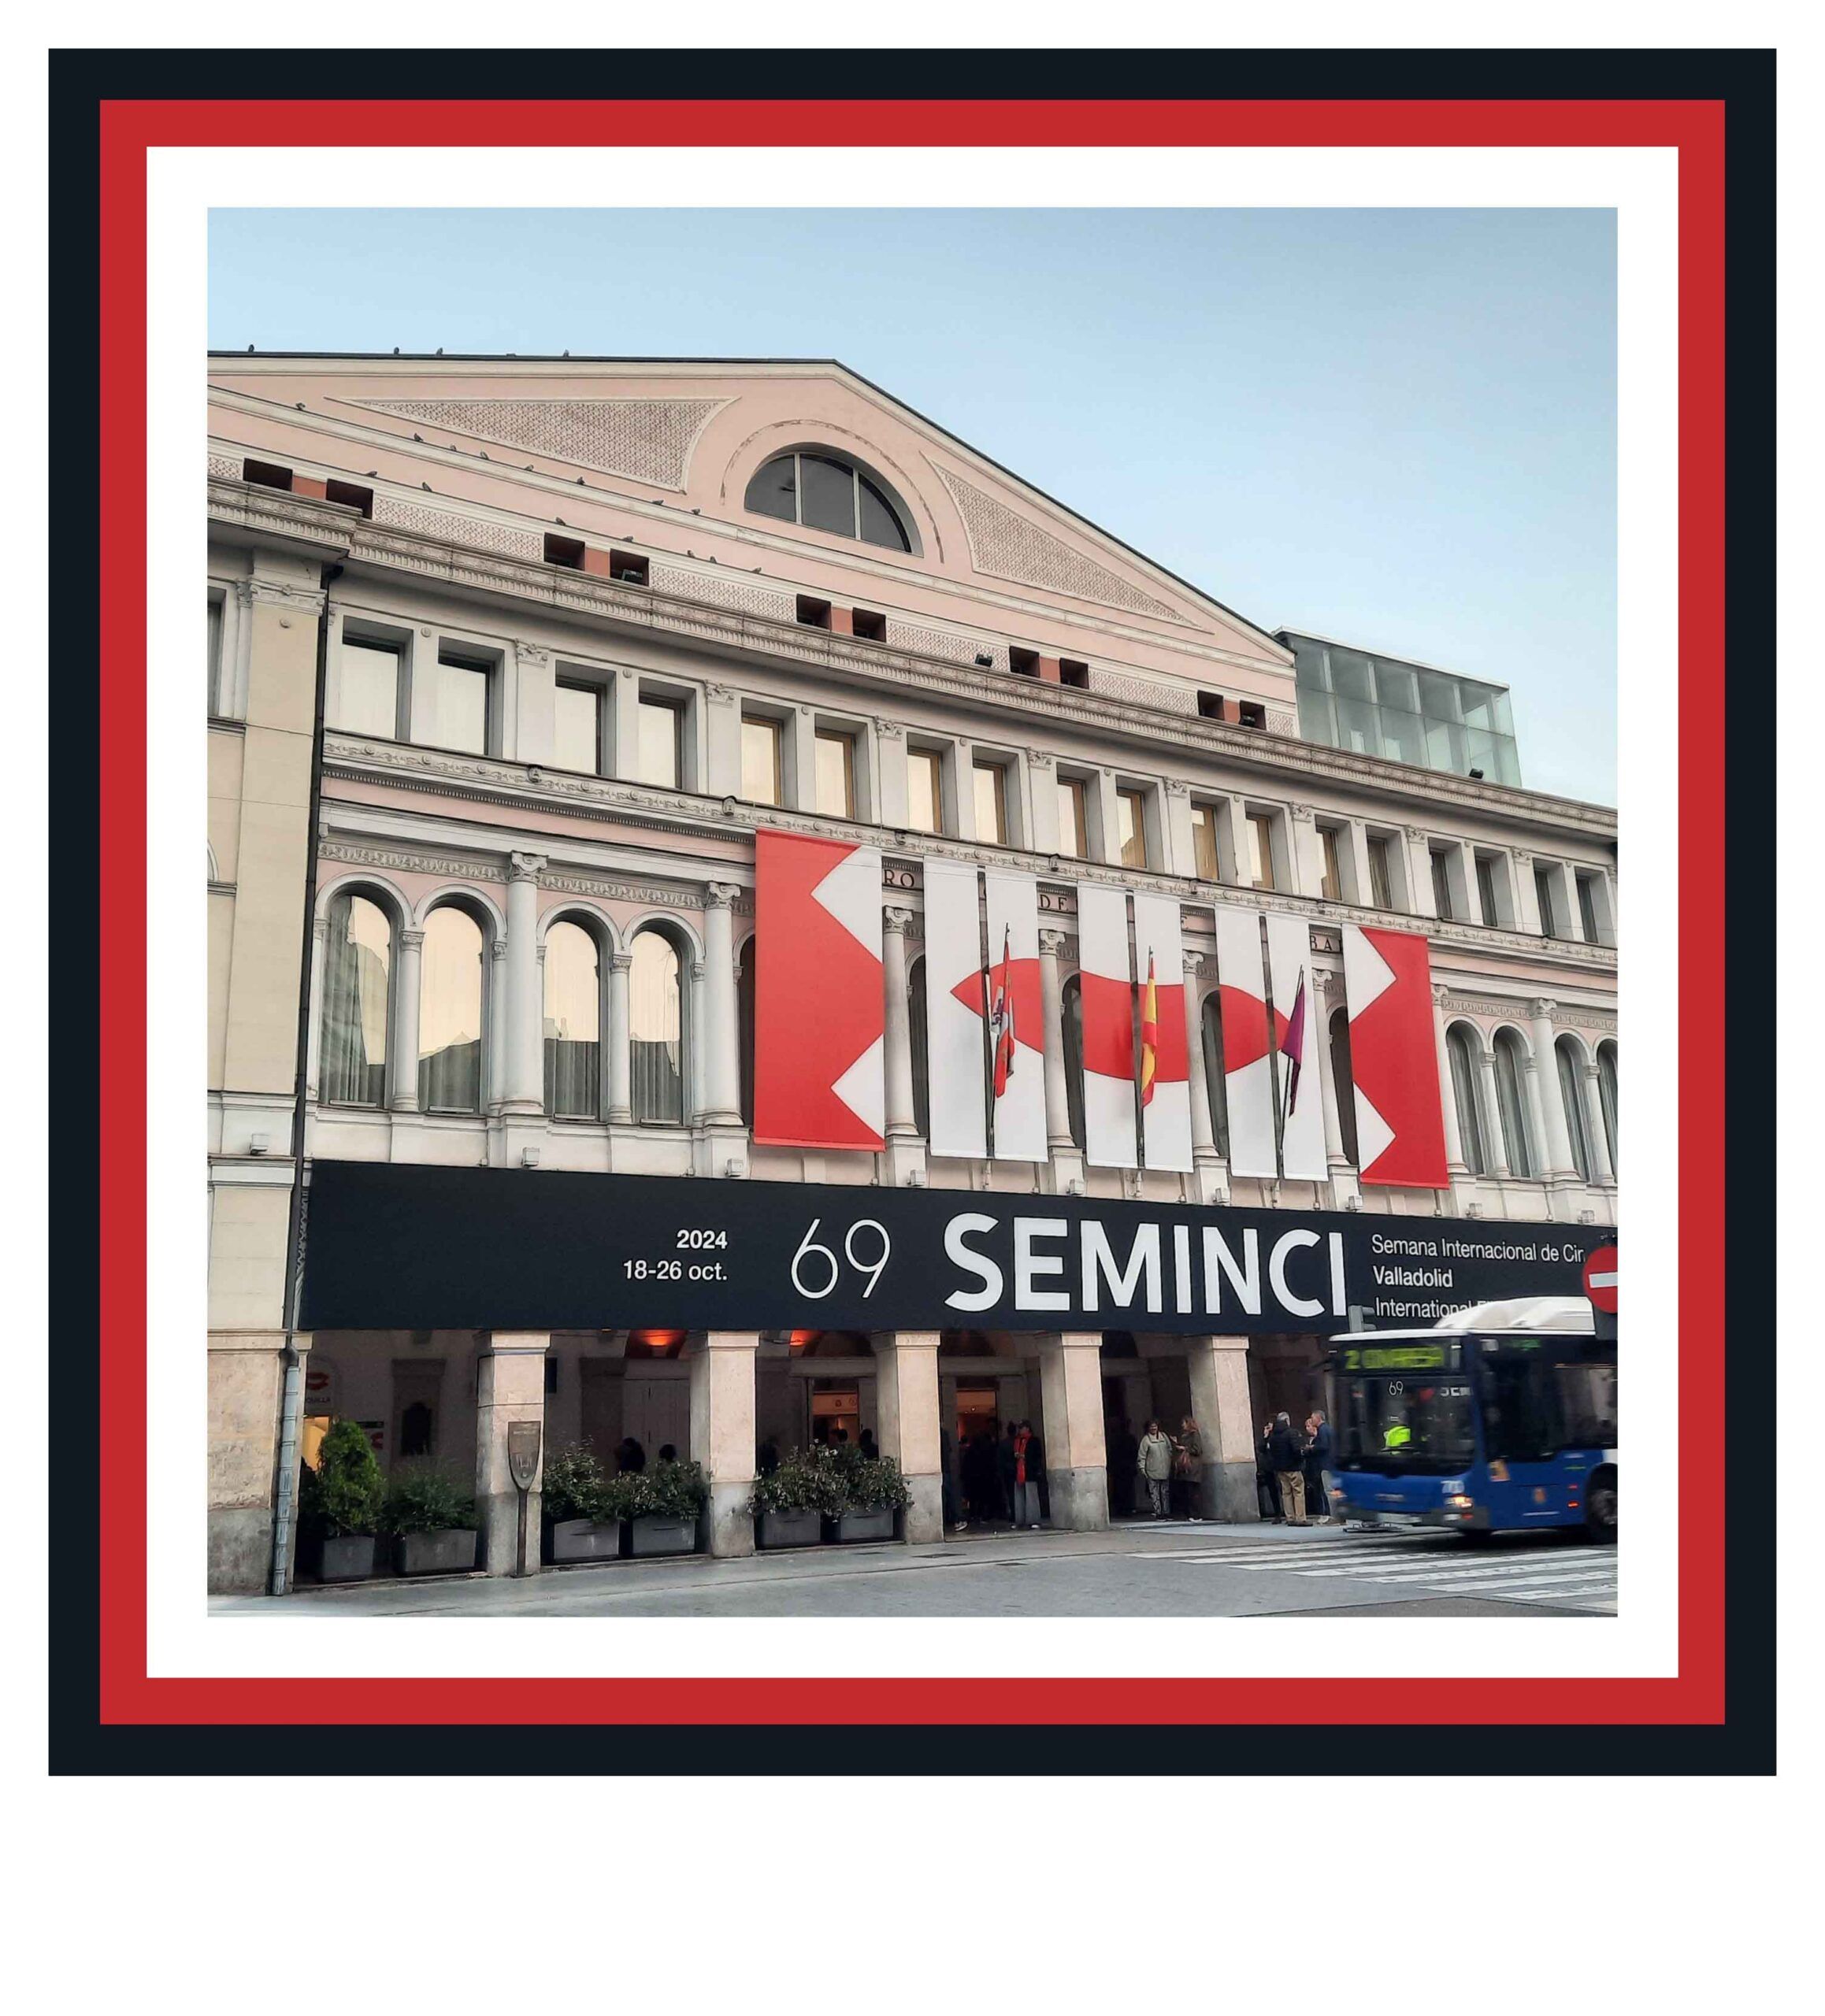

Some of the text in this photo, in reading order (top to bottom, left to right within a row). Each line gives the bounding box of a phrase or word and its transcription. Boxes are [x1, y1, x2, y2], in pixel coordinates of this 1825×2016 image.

[676, 1229, 728, 1249] 2024
[1371, 1233, 1438, 1257] Semana
[1441, 1238, 1537, 1261] Internacional
[1541, 1243, 1560, 1262] de
[623, 1259, 728, 1280] 18-26 oct.
[791, 1212, 1347, 1317] 69 SEMINCI
[1372, 1265, 1453, 1288] Valladolid
[1344, 1350, 1361, 1369] 2
[1389, 1380, 1404, 1395] 69
